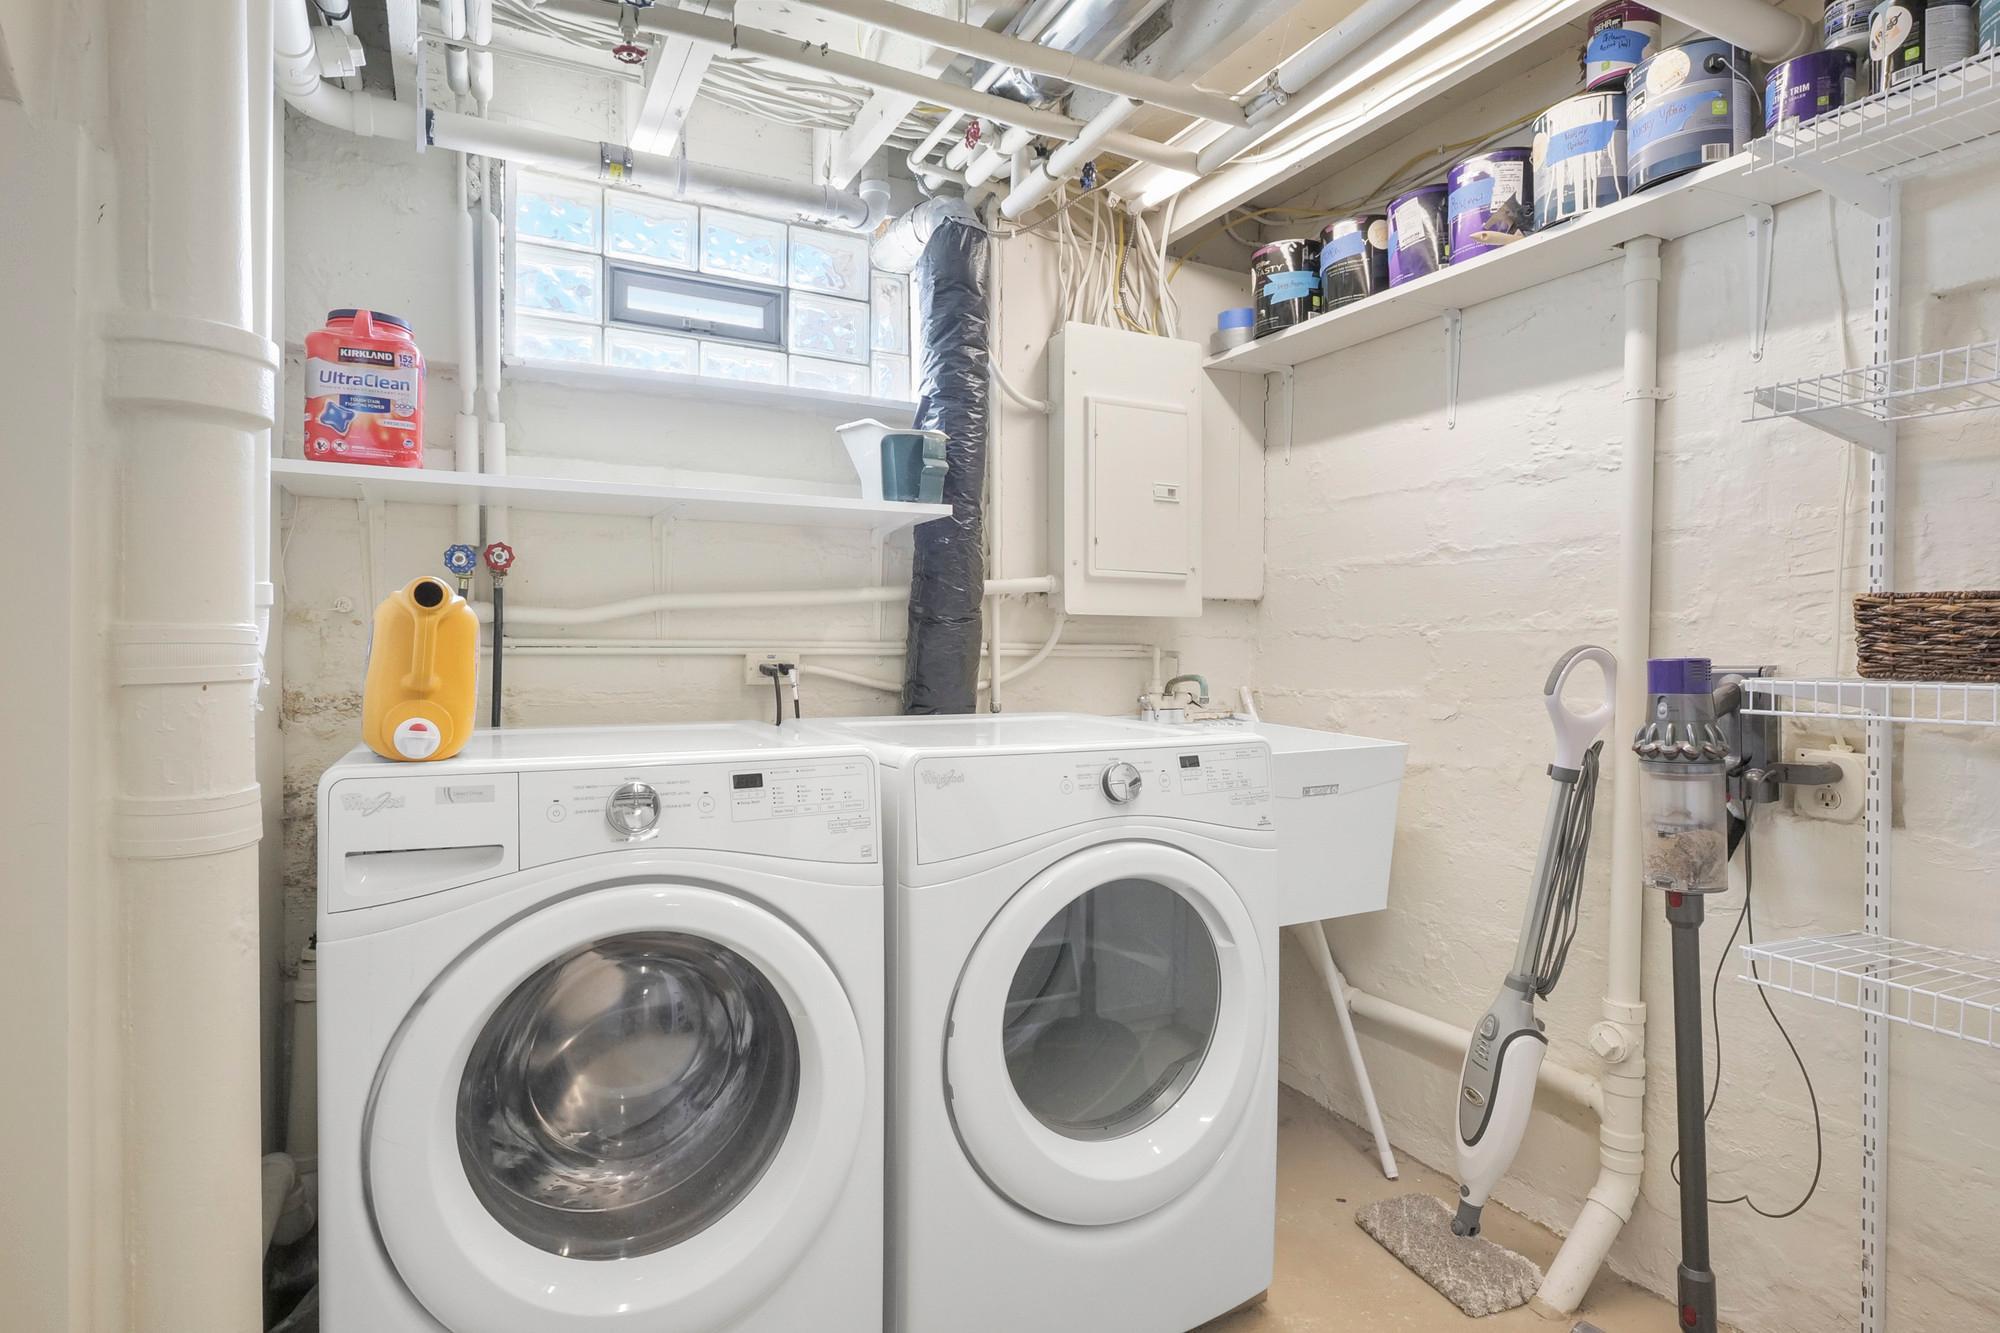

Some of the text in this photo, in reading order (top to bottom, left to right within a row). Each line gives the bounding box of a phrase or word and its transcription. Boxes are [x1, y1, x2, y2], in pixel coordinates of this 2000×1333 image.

[1595, 18, 1612, 34] BEHR
[1789, 82, 1811, 96] TRIM
[340, 348, 393, 361] KIRKLAND
[399, 354, 413, 364] 152
[319, 370, 410, 391] UltraClean
